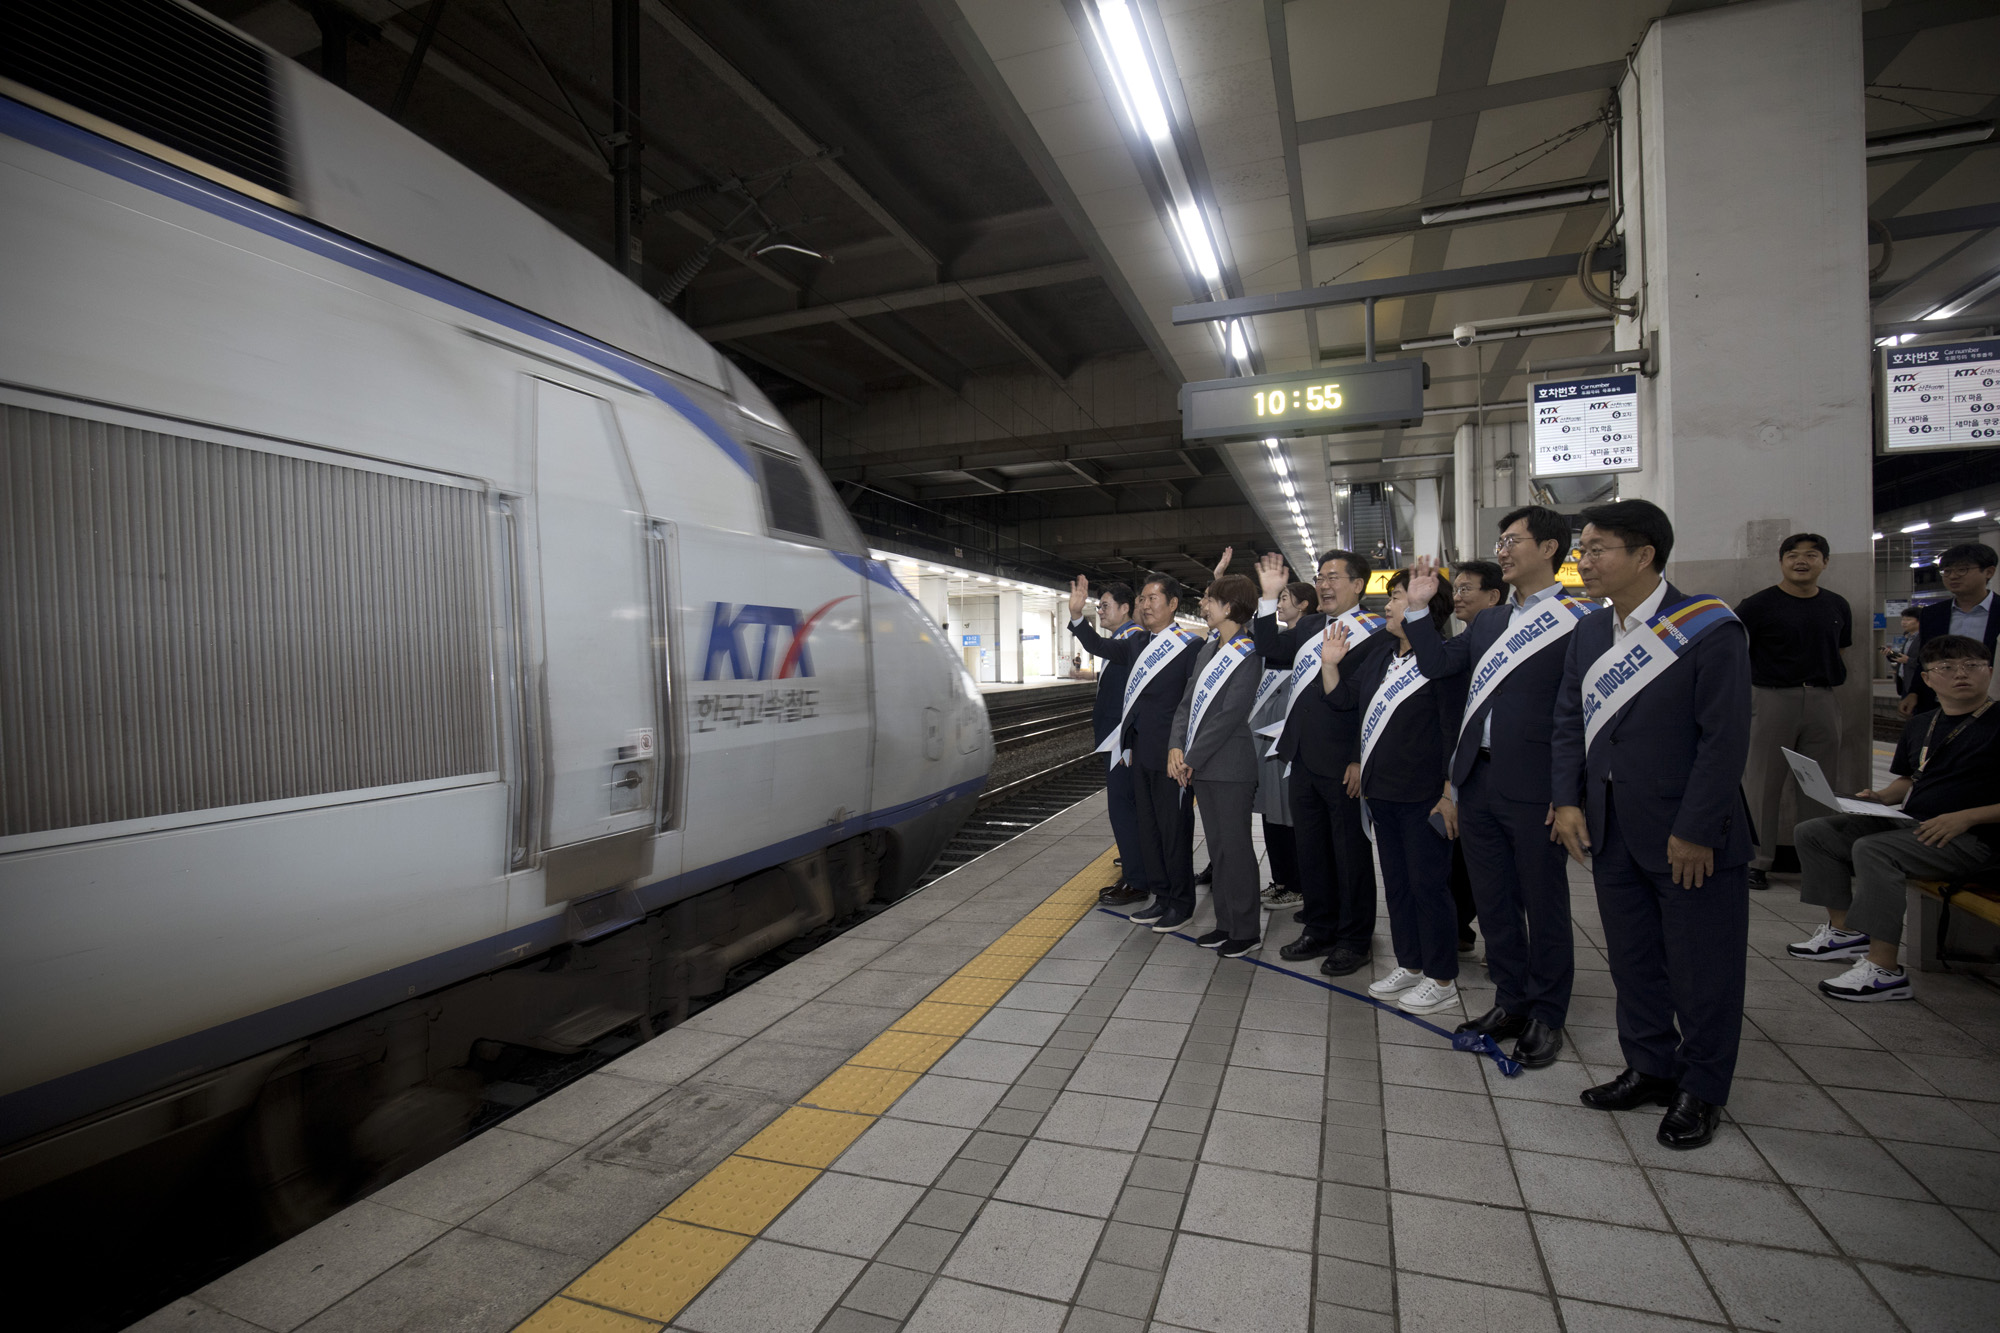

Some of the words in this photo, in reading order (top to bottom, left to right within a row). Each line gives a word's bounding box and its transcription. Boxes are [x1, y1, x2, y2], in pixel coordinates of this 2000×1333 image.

[1892, 350, 1939, 364] 호차번호
[1893, 371, 1921, 382] KTX
[1954, 366, 1983, 377] KTX
[1538, 386, 1577, 398] 호차번호
[1893, 383, 1919, 392] KTX
[1254, 384, 1342, 416] 10:55
[1955, 395, 1967, 403] ITX
[1539, 406, 1560, 415] KTX
[1590, 401, 1611, 410] KTX
[1539, 415, 1560, 424] KTX
[1893, 416, 1907, 424] ITX
[1909, 415, 1928, 423] 새마을
[1955, 419, 1979, 427] 새마을
[1590, 448, 1609, 456] 새마을
[1613, 446, 1632, 454] 무궁화
[1505, 611, 1559, 654] 민생을
[1657, 615, 1689, 645] 더불어민주당
[702, 594, 863, 681] KTX
[1144, 639, 1174, 669] 민생을
[1204, 655, 1233, 691] 민생을
[1594, 644, 1653, 699] 민생을
[1464, 651, 1508, 716] 살리겠습
[697, 689, 819, 733] 한국고속철도
